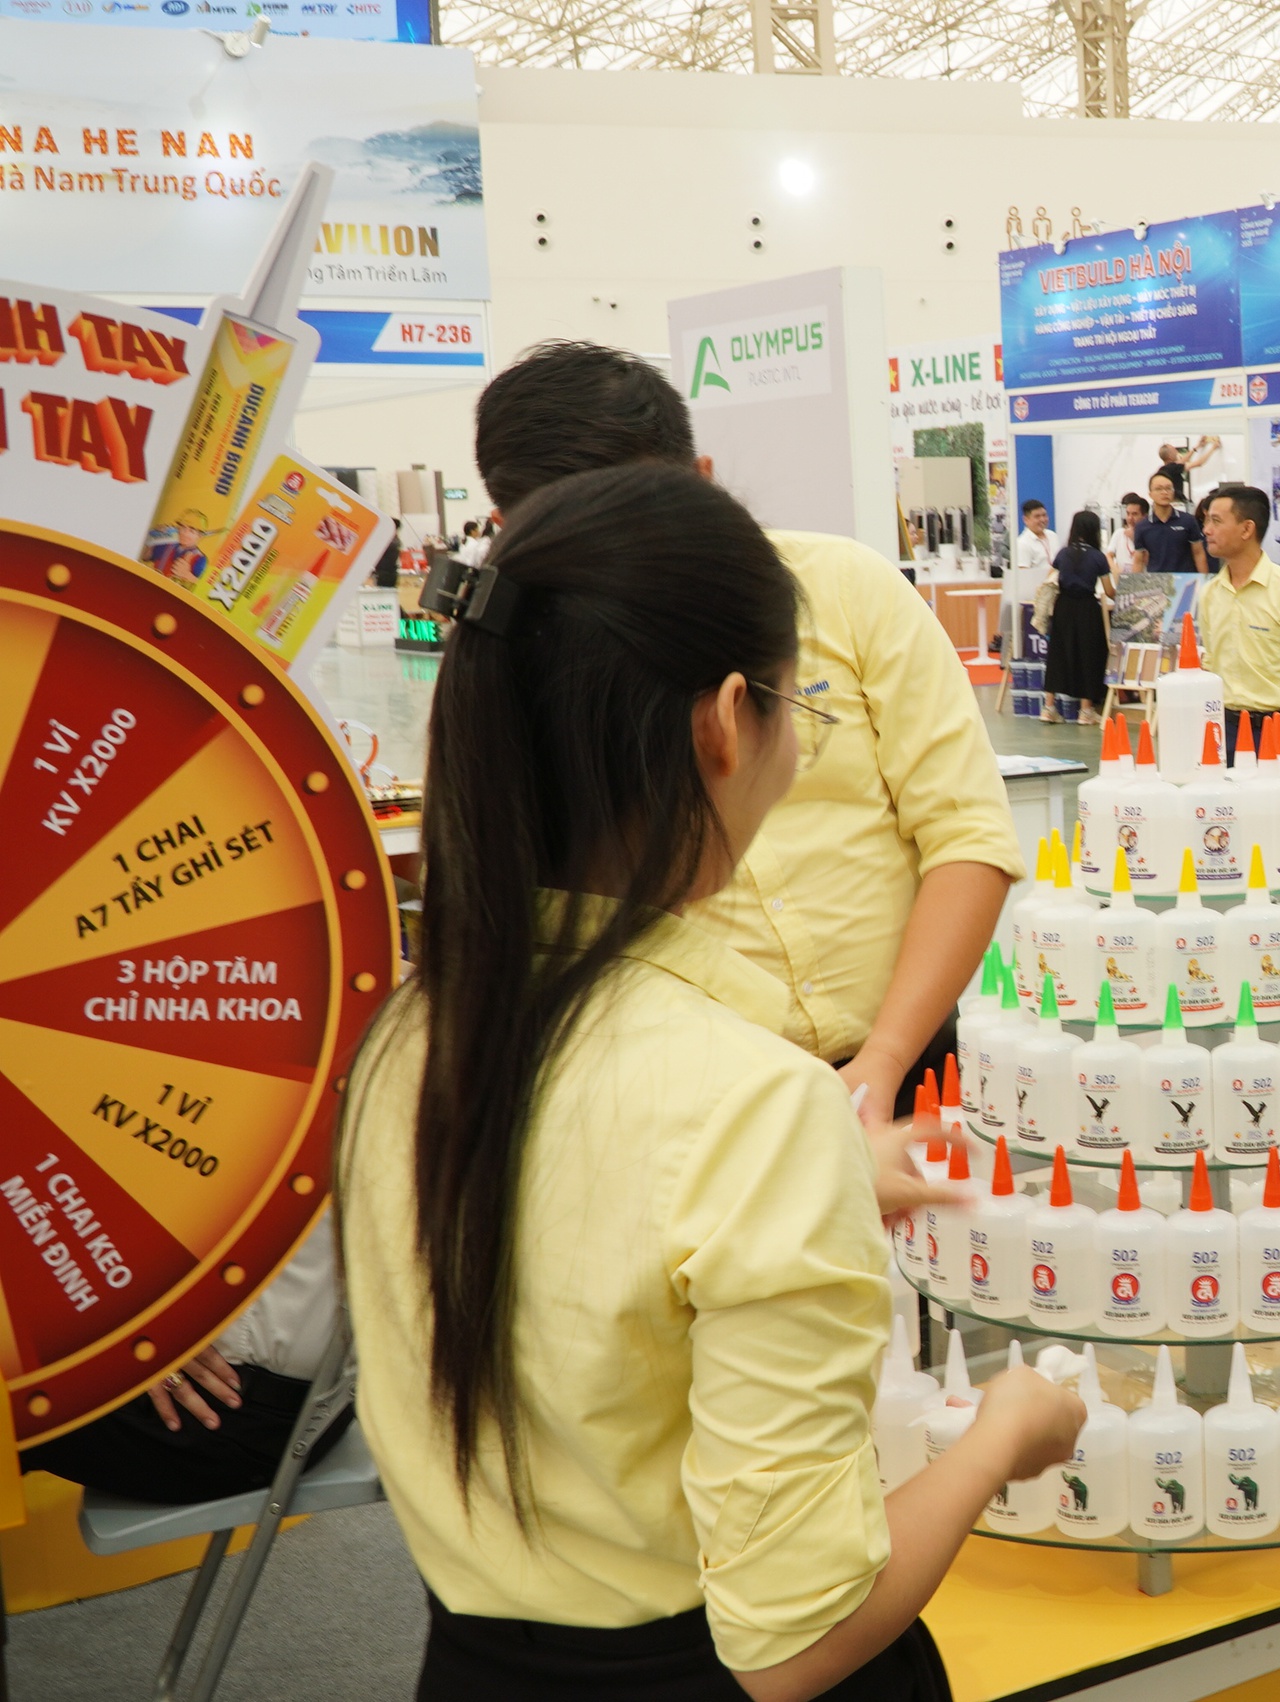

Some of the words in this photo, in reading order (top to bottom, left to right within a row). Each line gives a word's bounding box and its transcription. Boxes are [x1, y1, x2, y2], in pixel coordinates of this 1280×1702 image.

[82, 126, 140, 156] HE
[161, 129, 256, 160] NAN
[34, 166, 105, 193] Nam
[110, 167, 197, 200] Trung
[205, 167, 282, 200] Quốc
[314, 222, 440, 257] VILION
[1038, 257, 1126, 295] VIETBUILD
[1128, 244, 1156, 281] HÀ
[1157, 240, 1192, 282] NỘI
[68, 310, 191, 386] TAY
[401, 323, 472, 344] H7-236
[731, 322, 823, 362] OLYMPUS
[911, 352, 981, 387] X-LINE
[231, 382, 266, 451] DUCANH
[21, 390, 155, 484] TAY
[214, 450, 243, 497] BOND
[207, 516, 279, 613] X2000
[34, 757, 59, 775] 1
[41, 790, 82, 836] KV
[67, 707, 137, 796] X2000
[1215, 806, 1234, 817] 502
[112, 852, 130, 874] 1
[136, 814, 207, 863] CHAI
[74, 903, 109, 939] A7
[230, 819, 275, 862] SÉT
[1113, 935, 1134, 947] 502
[1196, 935, 1215, 947] 502
[117, 960, 136, 984] 3
[143, 955, 209, 990] HỘP
[213, 955, 278, 984] TĂM
[144, 997, 211, 1022] NHA
[217, 997, 302, 1022] KHOA
[156, 1083, 174, 1106] 1
[1095, 1074, 1116, 1085] 502
[1181, 1077, 1201, 1089] 502
[1252, 1077, 1272, 1089] 502
[92, 1093, 138, 1129] KV
[132, 1116, 220, 1179] X2000
[35, 1152, 60, 1173] 1
[47, 1173, 102, 1239] CHAI
[970, 1229, 988, 1246] 502
[1031, 1239, 1055, 1255] 502
[84, 1233, 133, 1289] KEO
[1112, 1249, 1139, 1263] 502
[1192, 1250, 1219, 1264] 502
[41, 1241, 100, 1313] ĐINH
[1154, 1451, 1183, 1465] 502
[1228, 1448, 1256, 1461] 502
